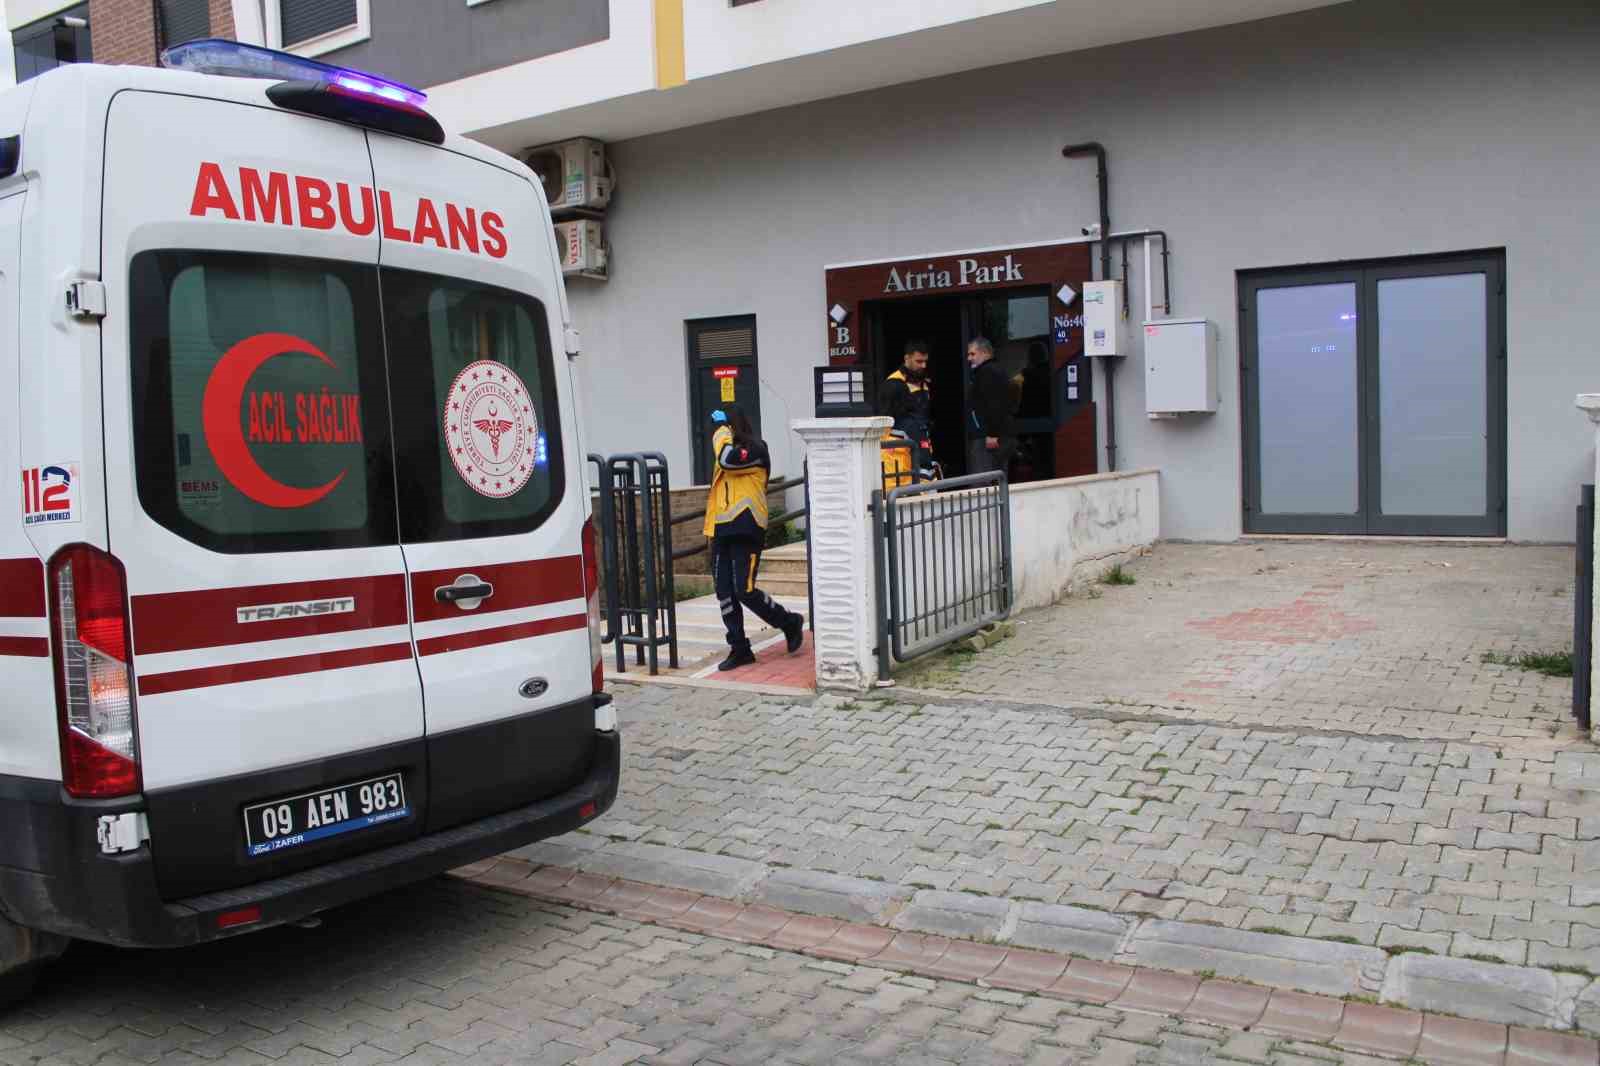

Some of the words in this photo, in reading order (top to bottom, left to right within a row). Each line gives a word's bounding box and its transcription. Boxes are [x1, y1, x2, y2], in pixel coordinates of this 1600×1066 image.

[190, 161, 507, 258] AMBULANS
[884, 264, 952, 292] Atria
[957, 254, 1023, 285] Park
[831, 346, 856, 356] BLOK
[836, 327, 849, 344] B
[296, 386, 362, 443] SAĞLIK
[23, 466, 70, 513] 112
[238, 600, 352, 621] TRANSIT
[262, 804, 293, 838] 09
[307, 790, 349, 828] AEN
[360, 779, 399, 814] 983
[275, 833, 304, 849] ZAFER
